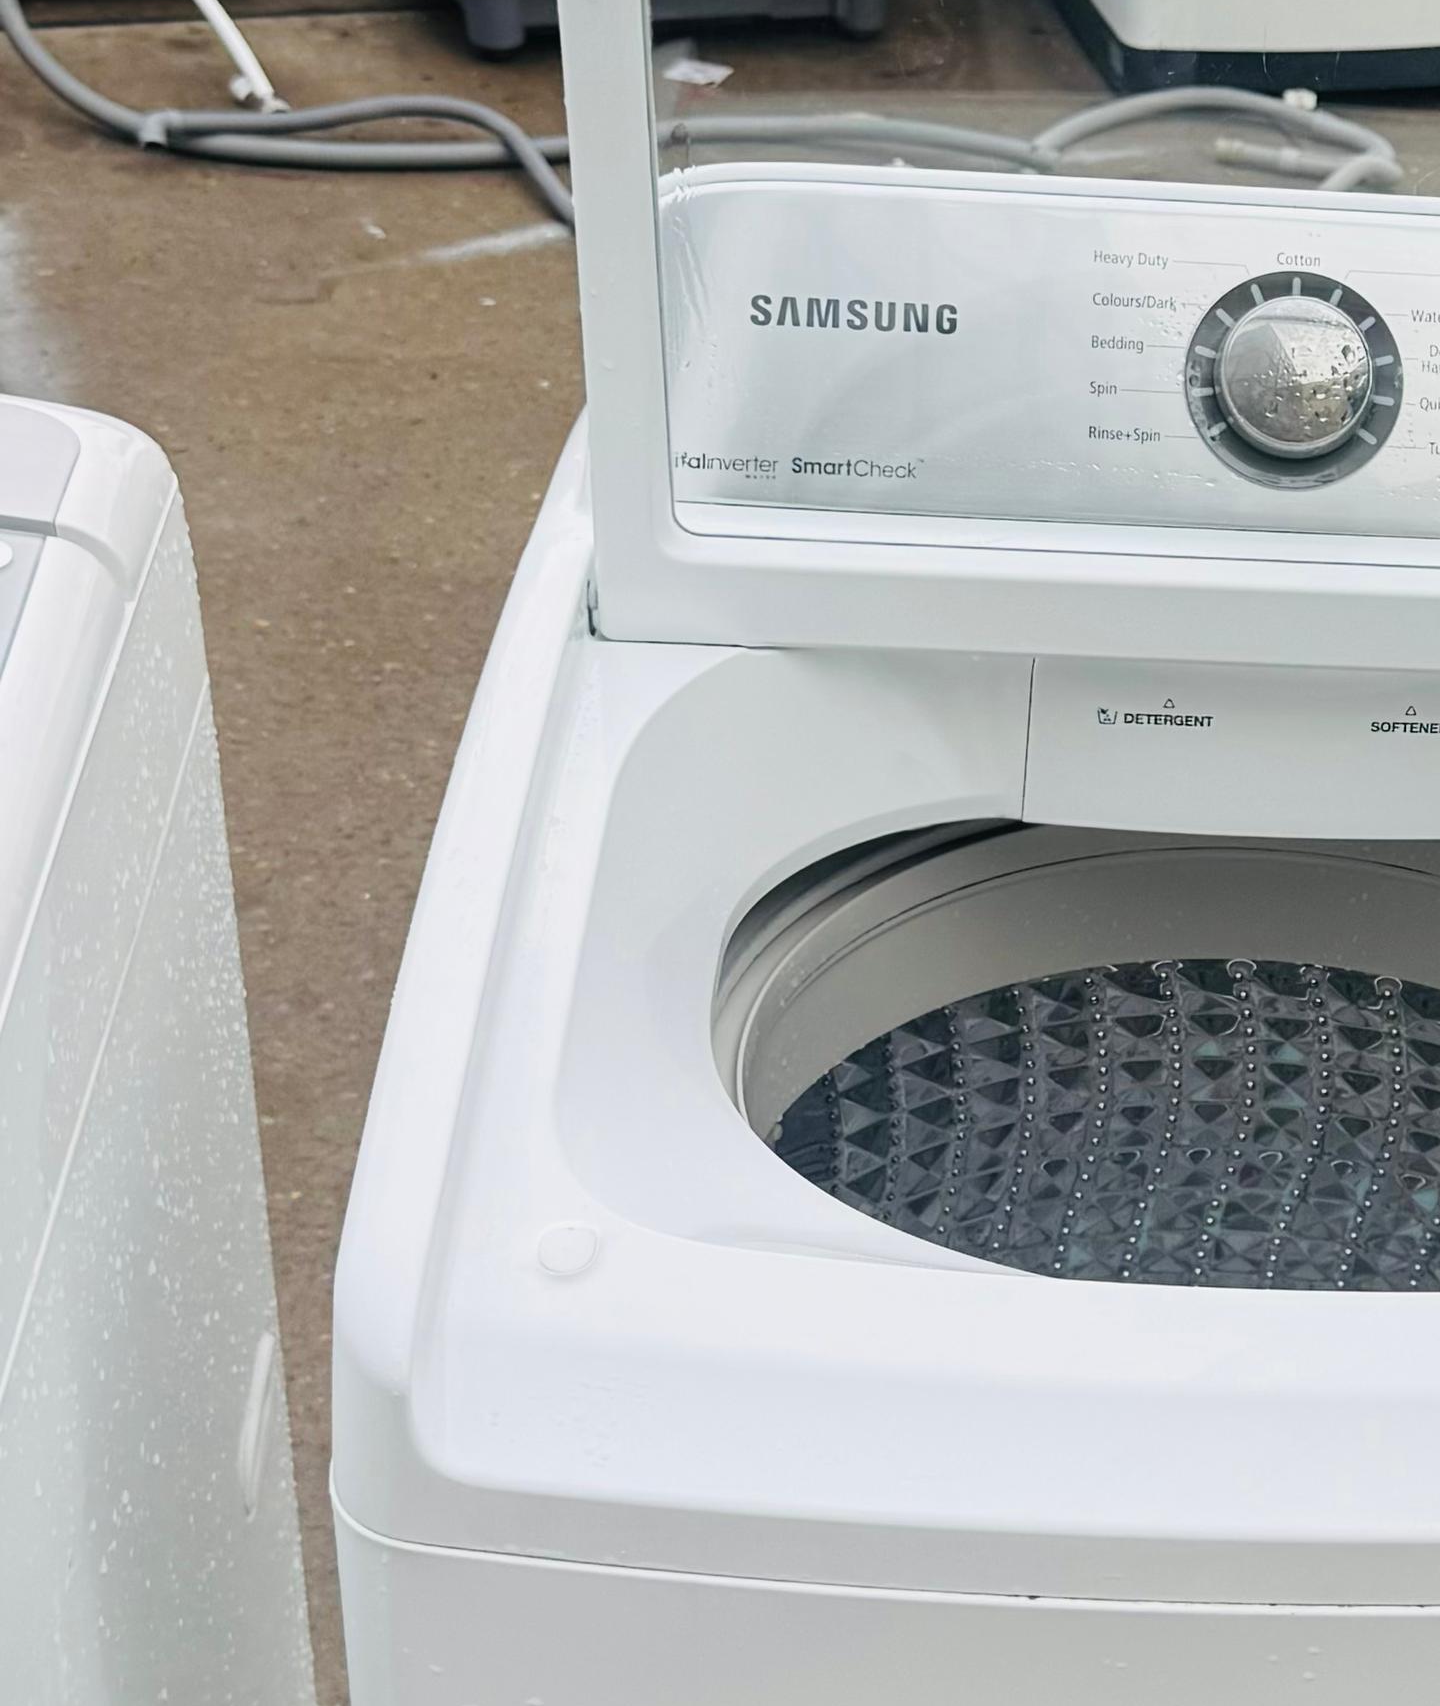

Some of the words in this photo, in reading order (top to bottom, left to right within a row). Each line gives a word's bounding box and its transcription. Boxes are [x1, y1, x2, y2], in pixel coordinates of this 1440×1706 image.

[1093, 250, 1134, 268] Heavy
[1138, 252, 1169, 270] Duty
[1277, 252, 1321, 268] Cotton
[1092, 292, 1176, 311] Colours/Dark
[750, 294, 958, 334] SAMSUNG
[1091, 335, 1144, 354] Bedding
[1089, 381, 1118, 397] Spin
[1088, 425, 1161, 444] Rinse+Spin
[1124, 712, 1213, 728] DETERGENT
